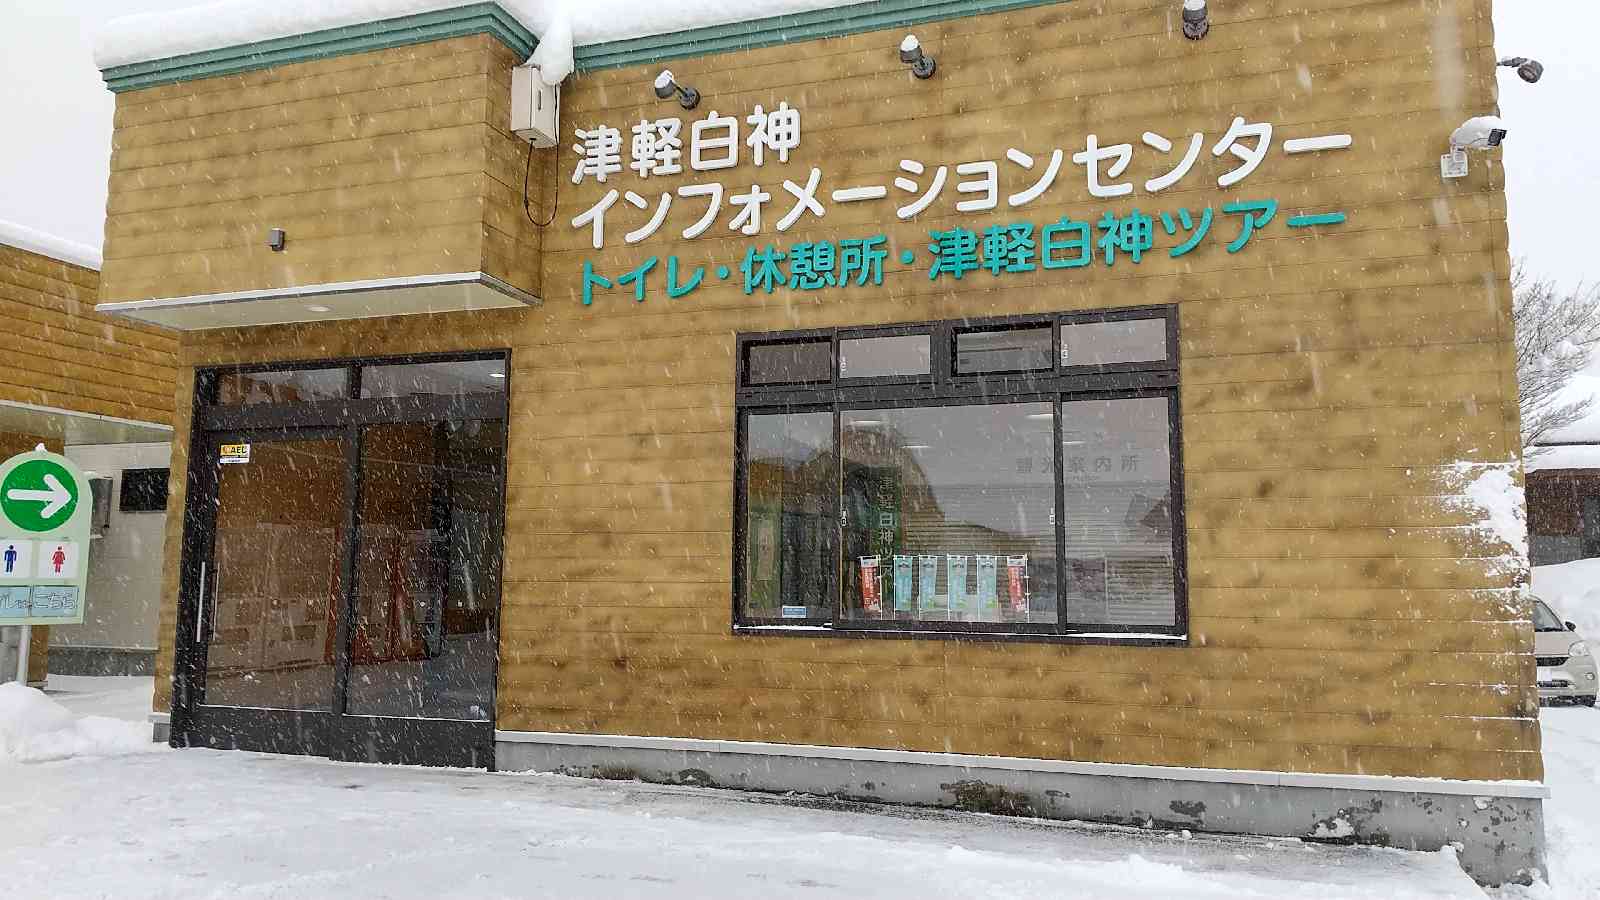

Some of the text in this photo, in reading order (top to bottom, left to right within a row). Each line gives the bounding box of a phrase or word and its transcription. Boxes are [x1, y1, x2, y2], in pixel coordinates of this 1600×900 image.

[571, 101, 801, 184] 津軽白神
[571, 116, 1353, 250] インフォメーションセンター
